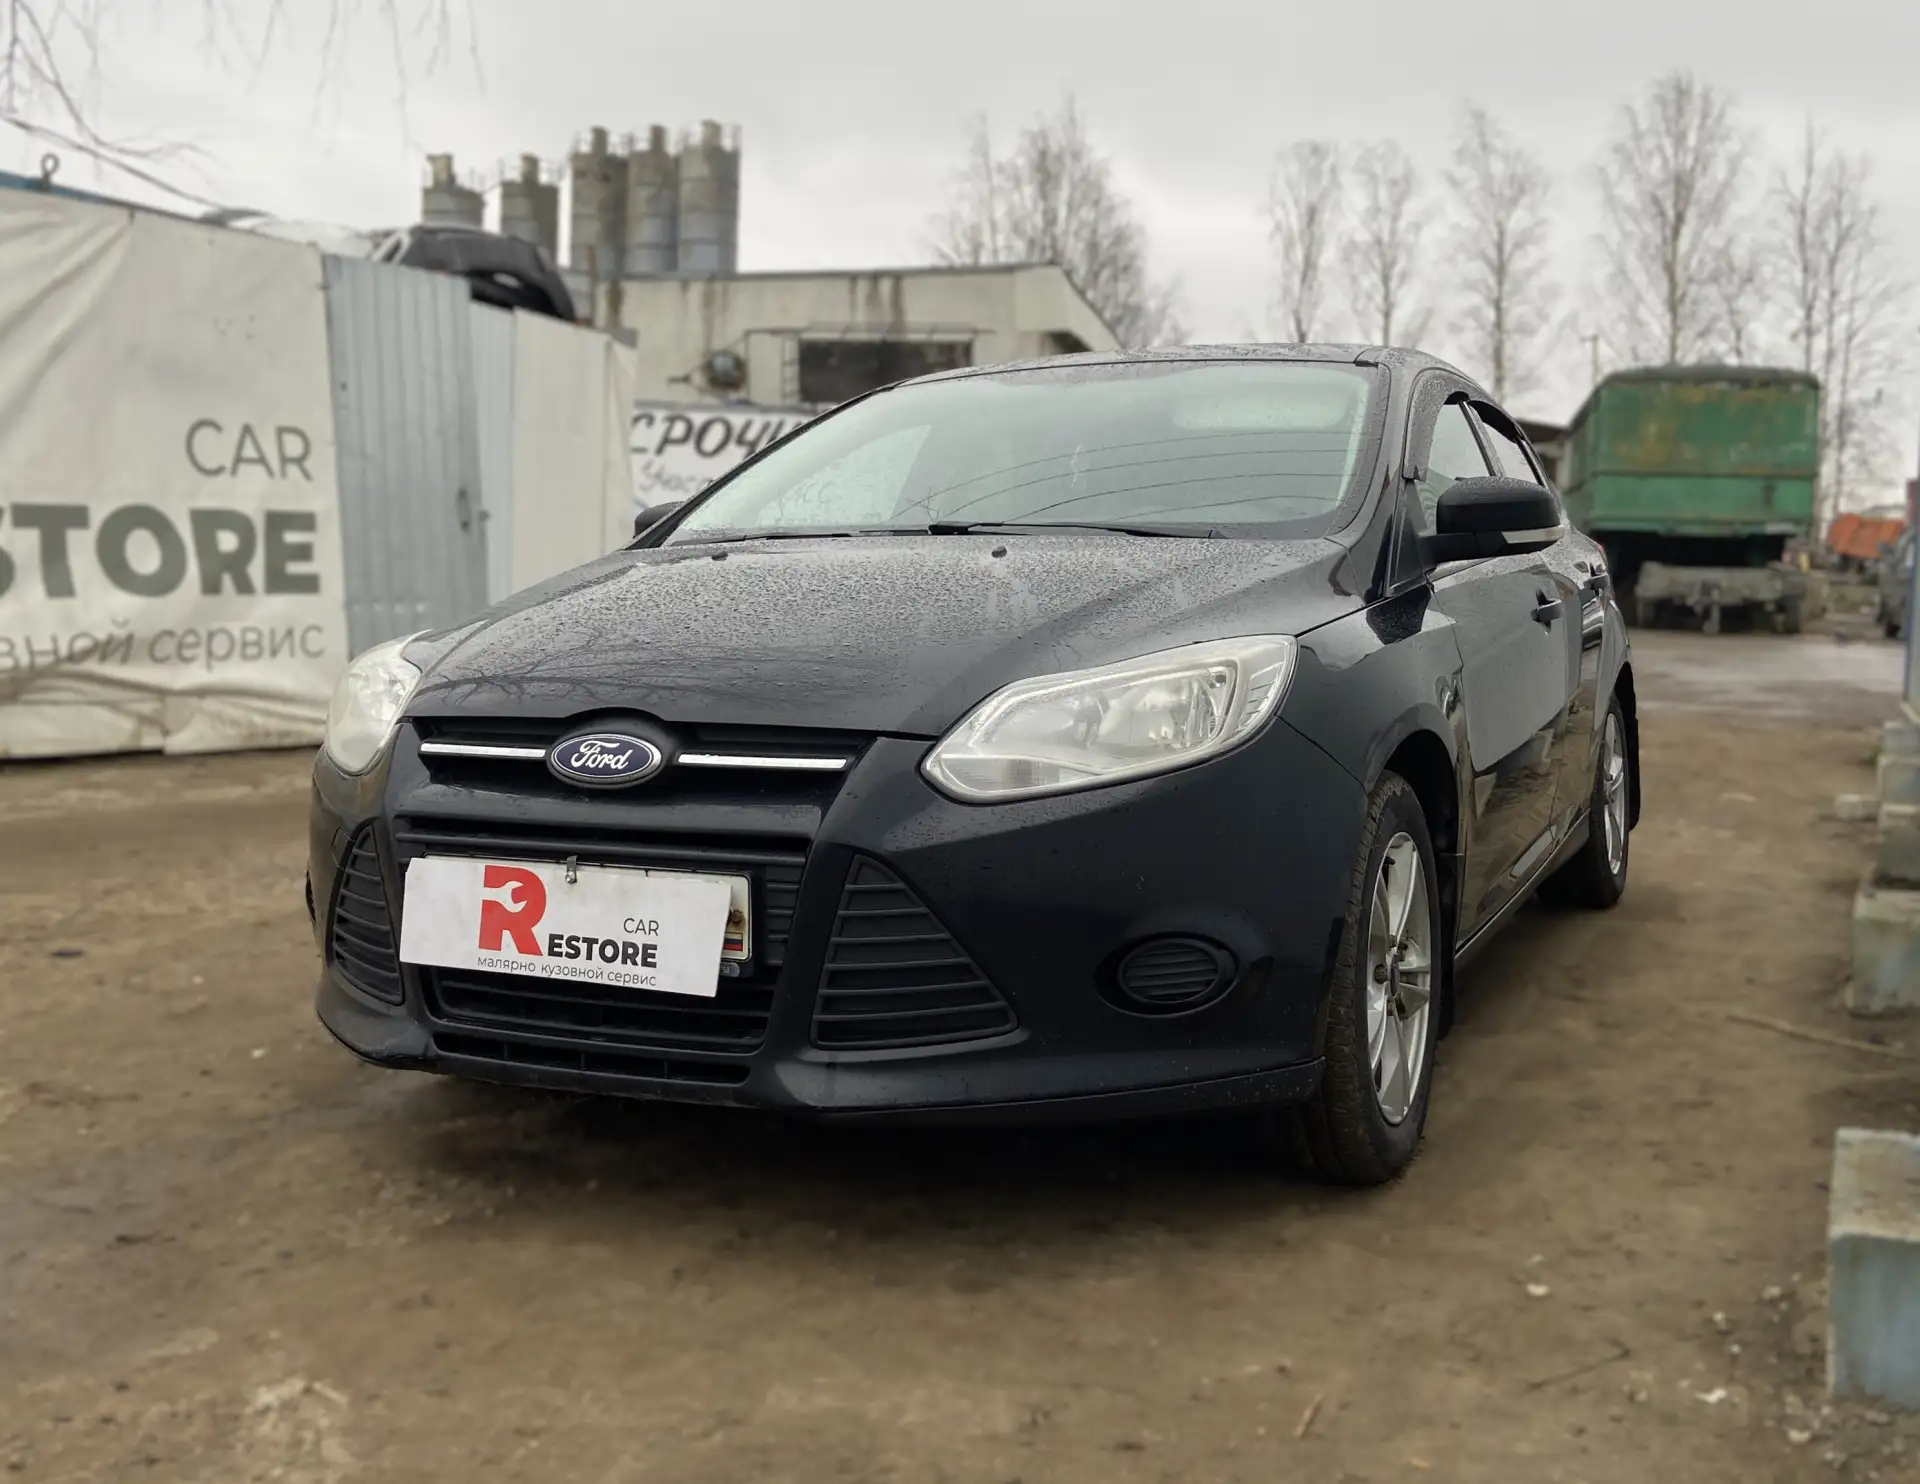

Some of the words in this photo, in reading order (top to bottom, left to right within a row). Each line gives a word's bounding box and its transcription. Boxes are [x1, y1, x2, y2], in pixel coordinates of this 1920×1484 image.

[185, 417, 313, 482] CAR
[147, 624, 326, 672] сервис
[570, 740, 634, 769] Ford
[623, 917, 660, 937] CAR
[477, 956, 536, 973] малярно
[541, 963, 604, 982] кузовной
[607, 969, 656, 986] сервис
